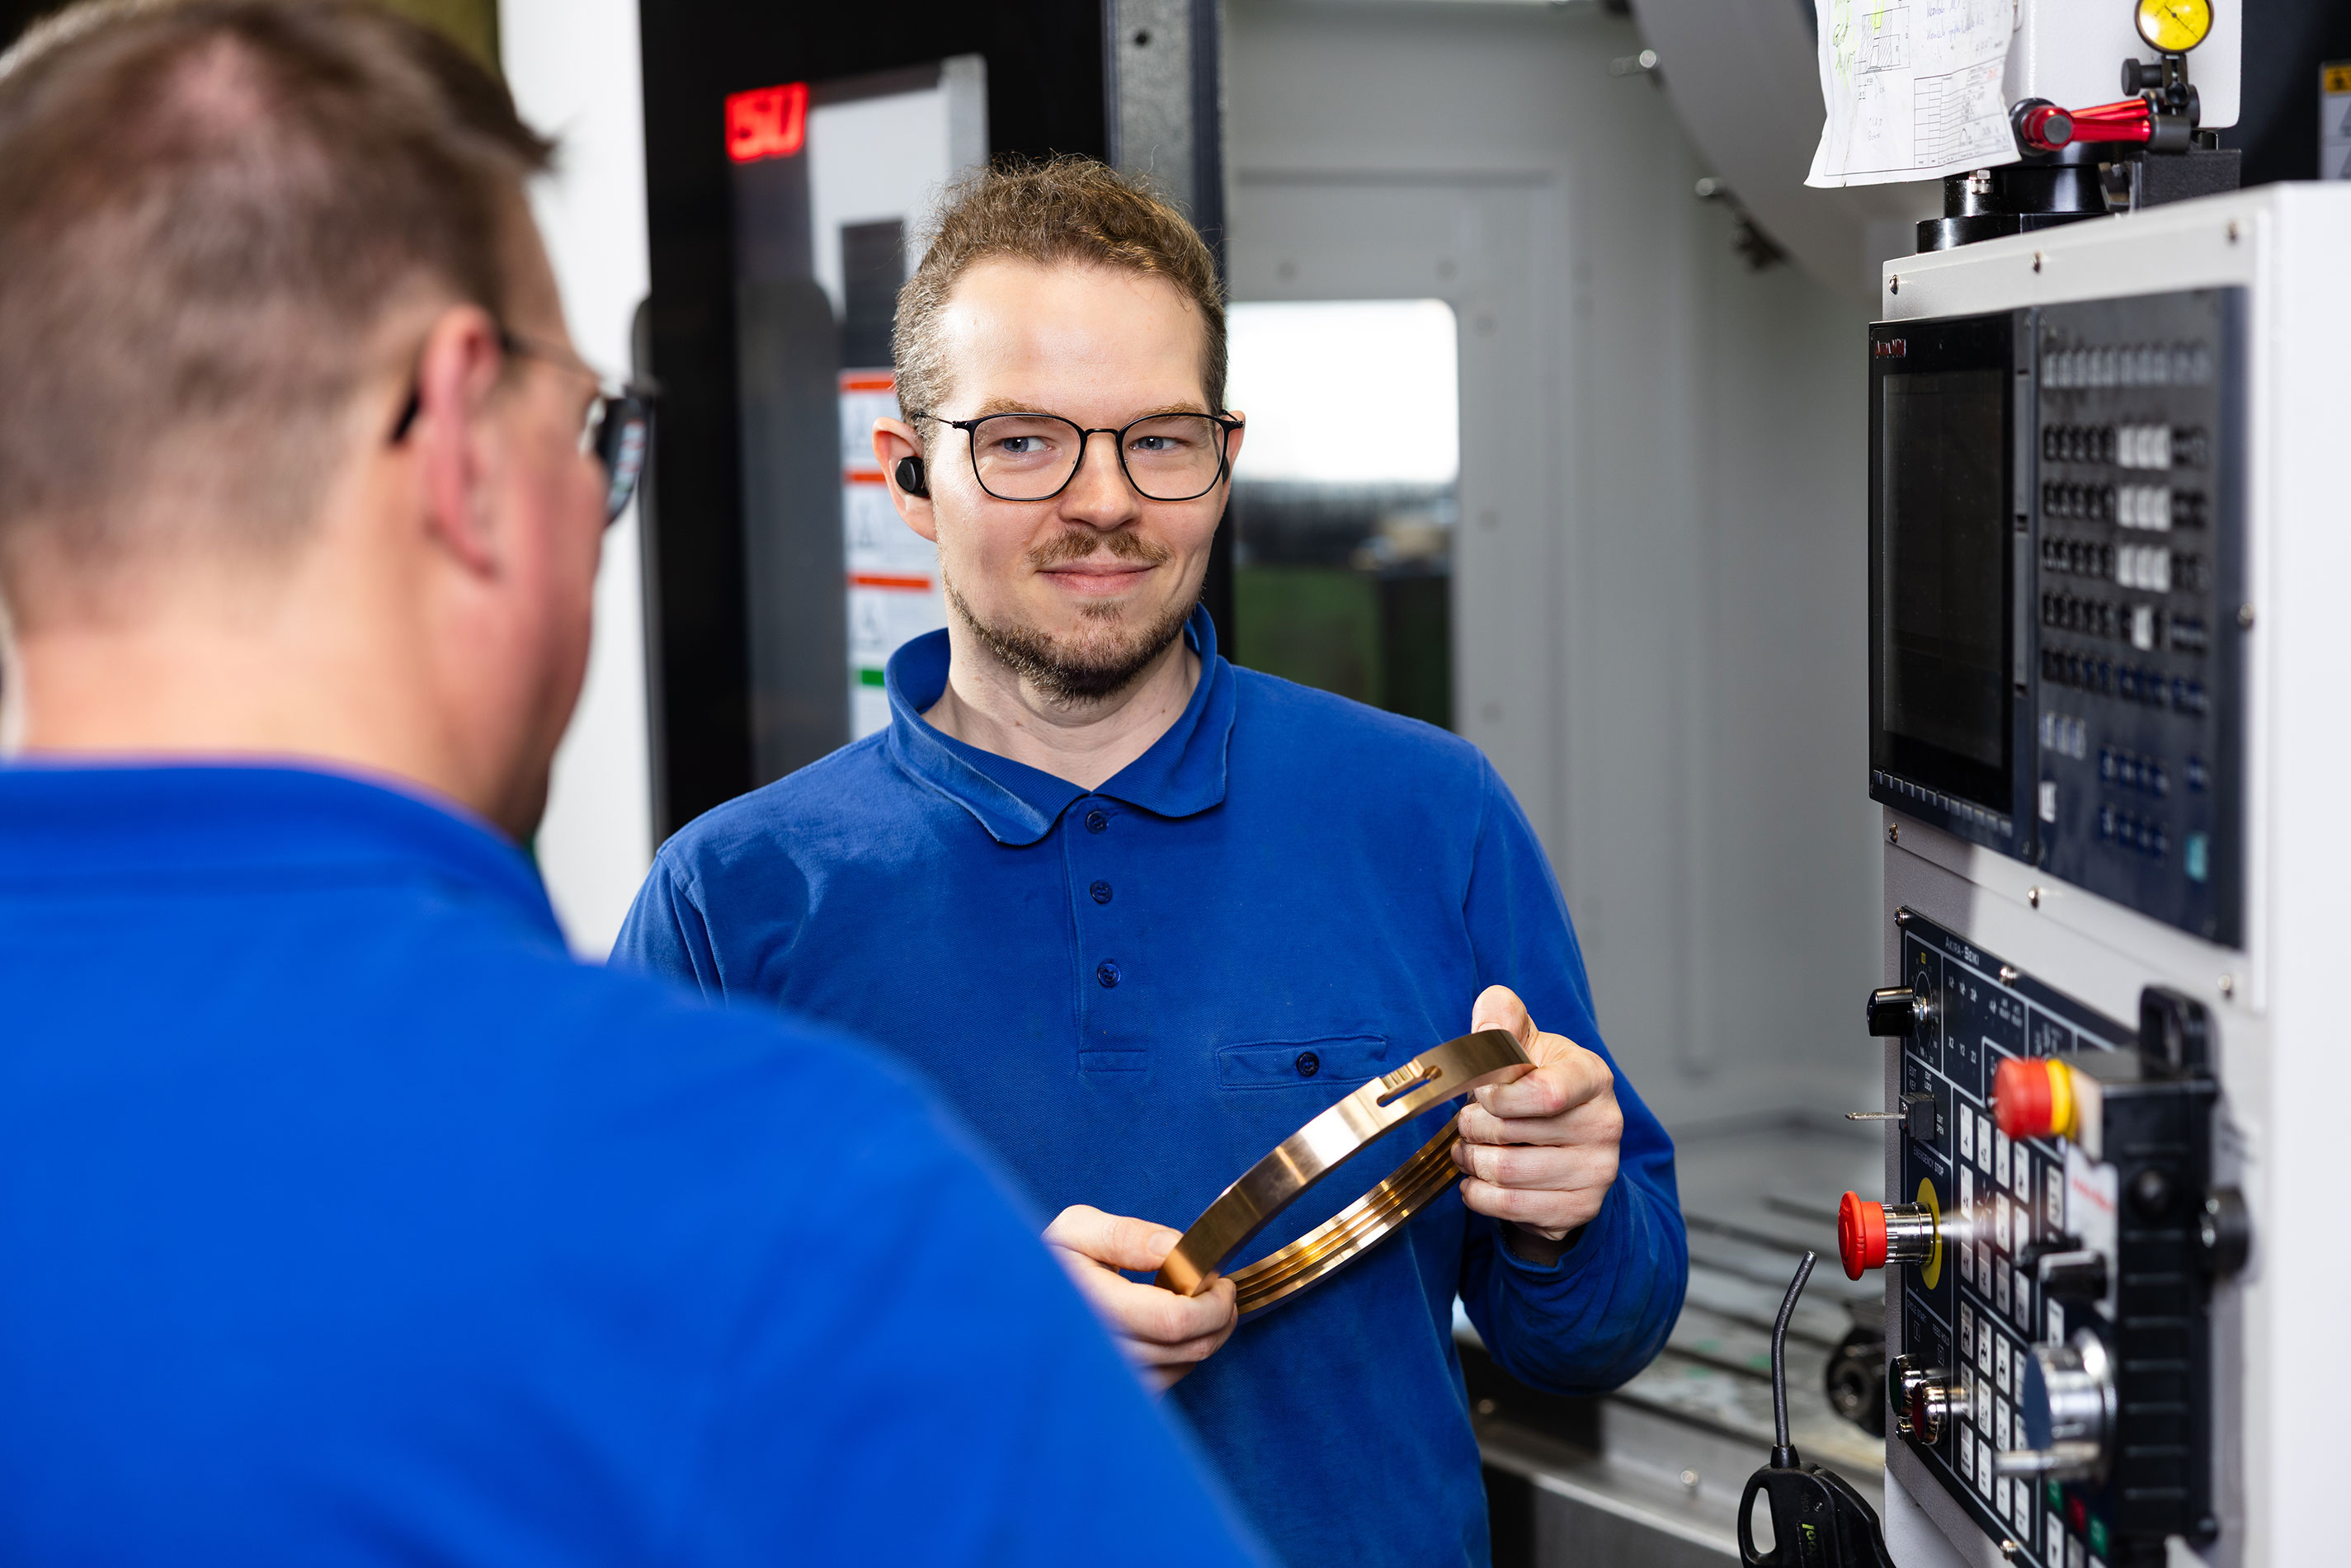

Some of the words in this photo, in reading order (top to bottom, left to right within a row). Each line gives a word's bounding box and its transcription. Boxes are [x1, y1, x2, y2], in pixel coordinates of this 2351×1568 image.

[1913, 1145, 1934, 1169] EMERGENCY
[1934, 1161, 1944, 1177] STOP
[1941, 1332, 1949, 1346] HOLD
